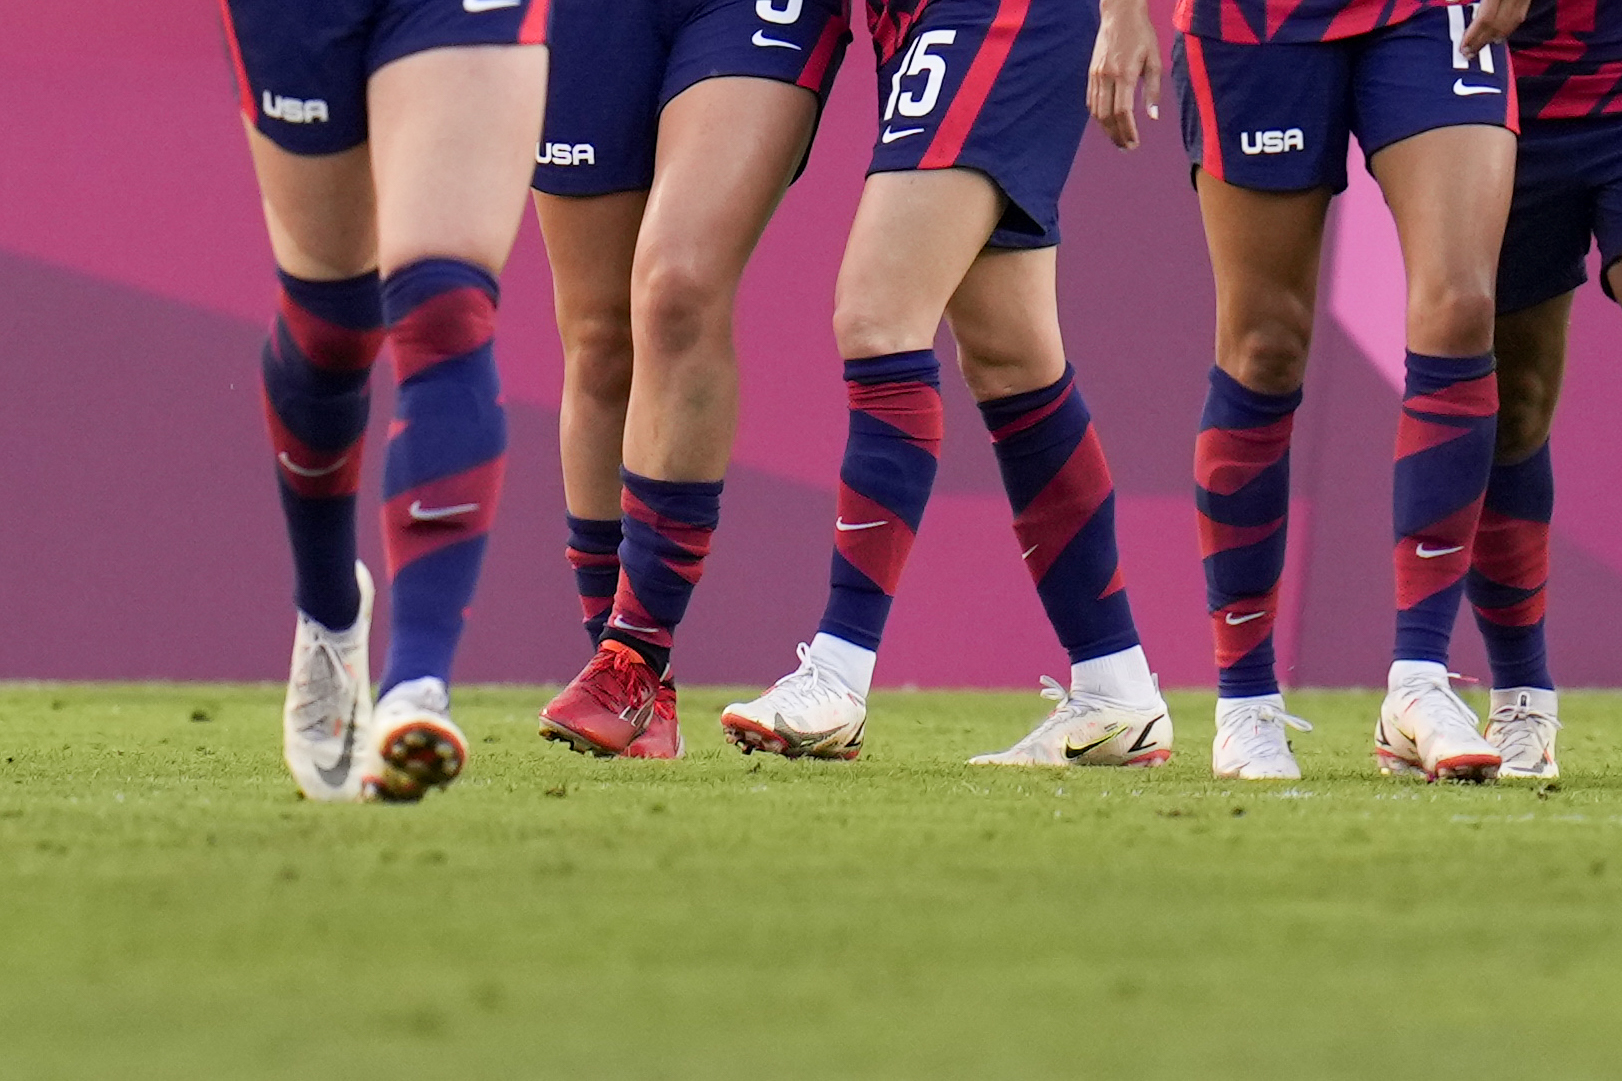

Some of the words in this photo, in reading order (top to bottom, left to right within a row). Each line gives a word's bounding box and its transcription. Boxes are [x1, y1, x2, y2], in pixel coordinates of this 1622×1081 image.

[883, 29, 957, 121] 15
[262, 90, 328, 124] USA
[535, 142, 595, 166] USA
[1240, 128, 1304, 155] USA
